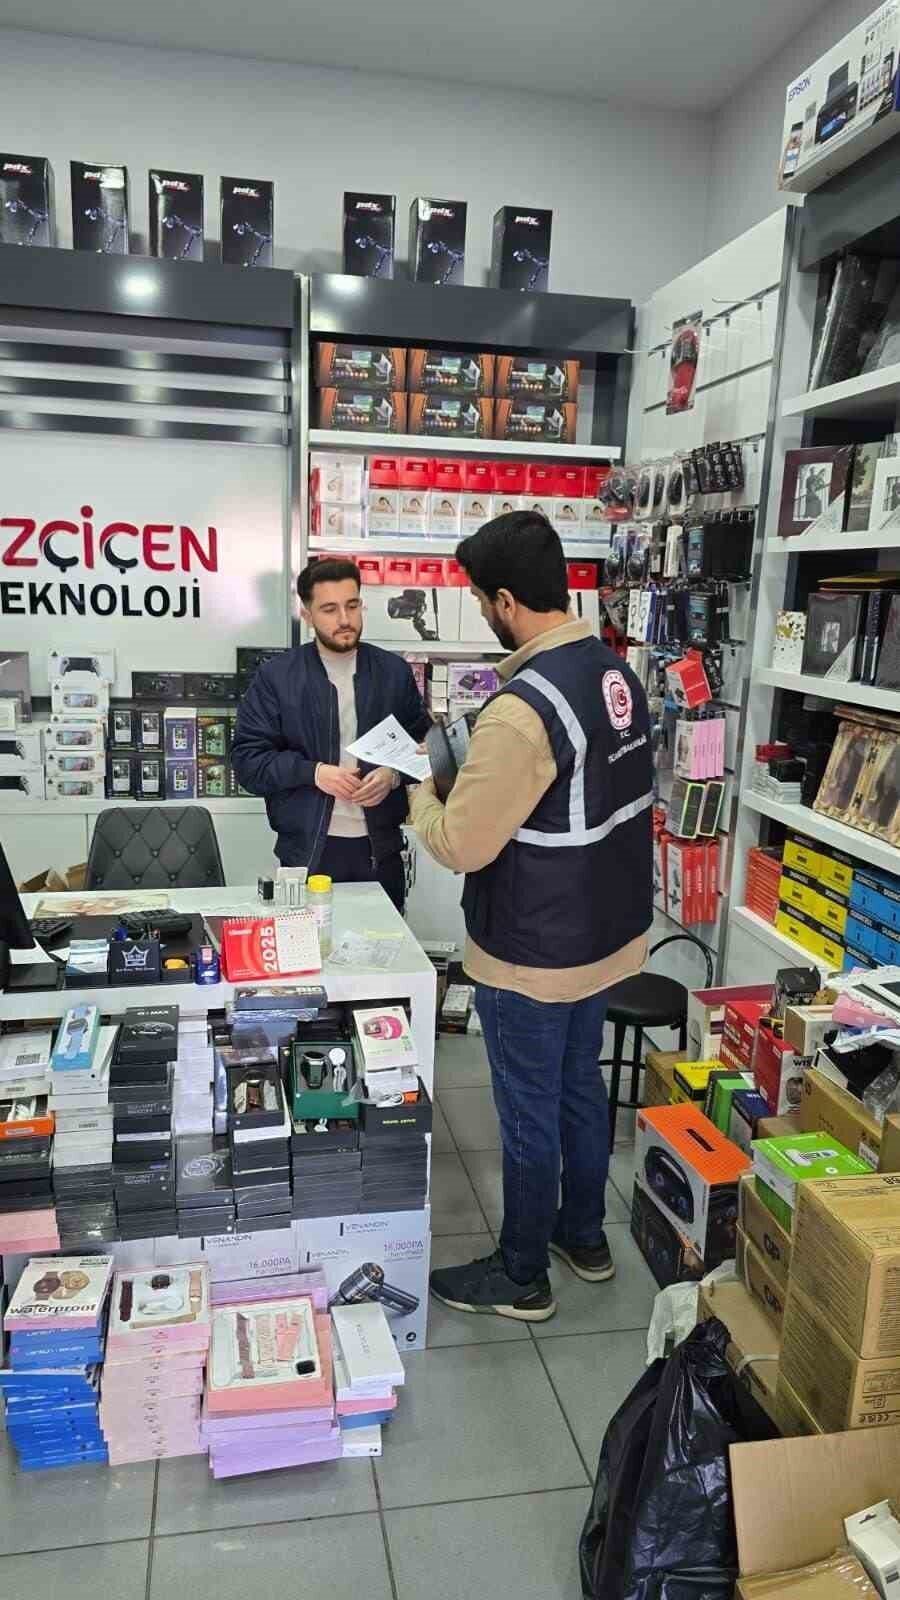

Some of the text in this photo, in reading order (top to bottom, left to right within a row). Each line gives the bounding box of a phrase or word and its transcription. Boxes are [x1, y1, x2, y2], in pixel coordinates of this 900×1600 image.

[0, 505, 218, 574] ZÇİÇEN
[0, 578, 201, 618] EKNOLOJİ
[261, 926, 278, 973] 2025
[10, 1303, 96, 1314] waterproof
